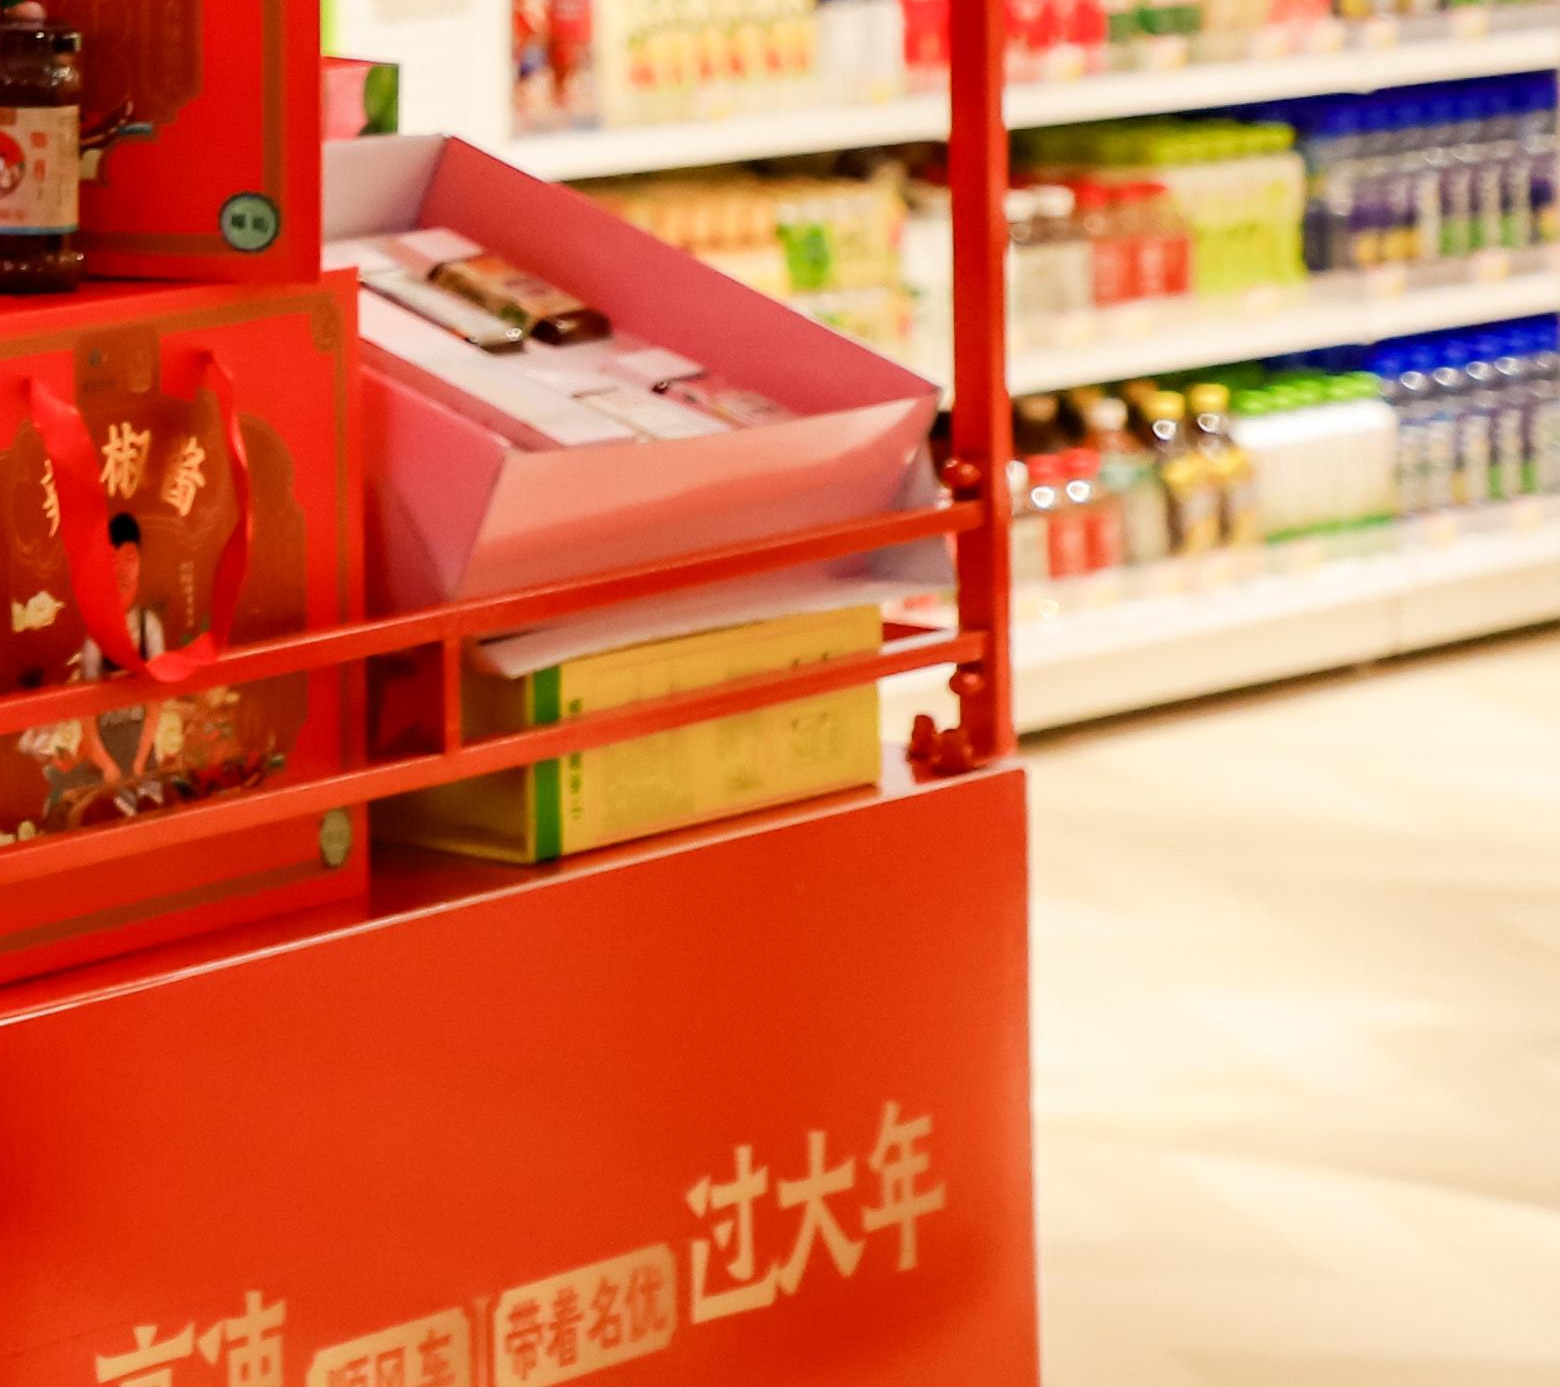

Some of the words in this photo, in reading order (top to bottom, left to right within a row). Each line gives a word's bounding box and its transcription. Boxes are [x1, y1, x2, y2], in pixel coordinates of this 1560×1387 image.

[503, 1264, 667, 1385] 带着名优
[684, 1100, 945, 1325] 过大年
